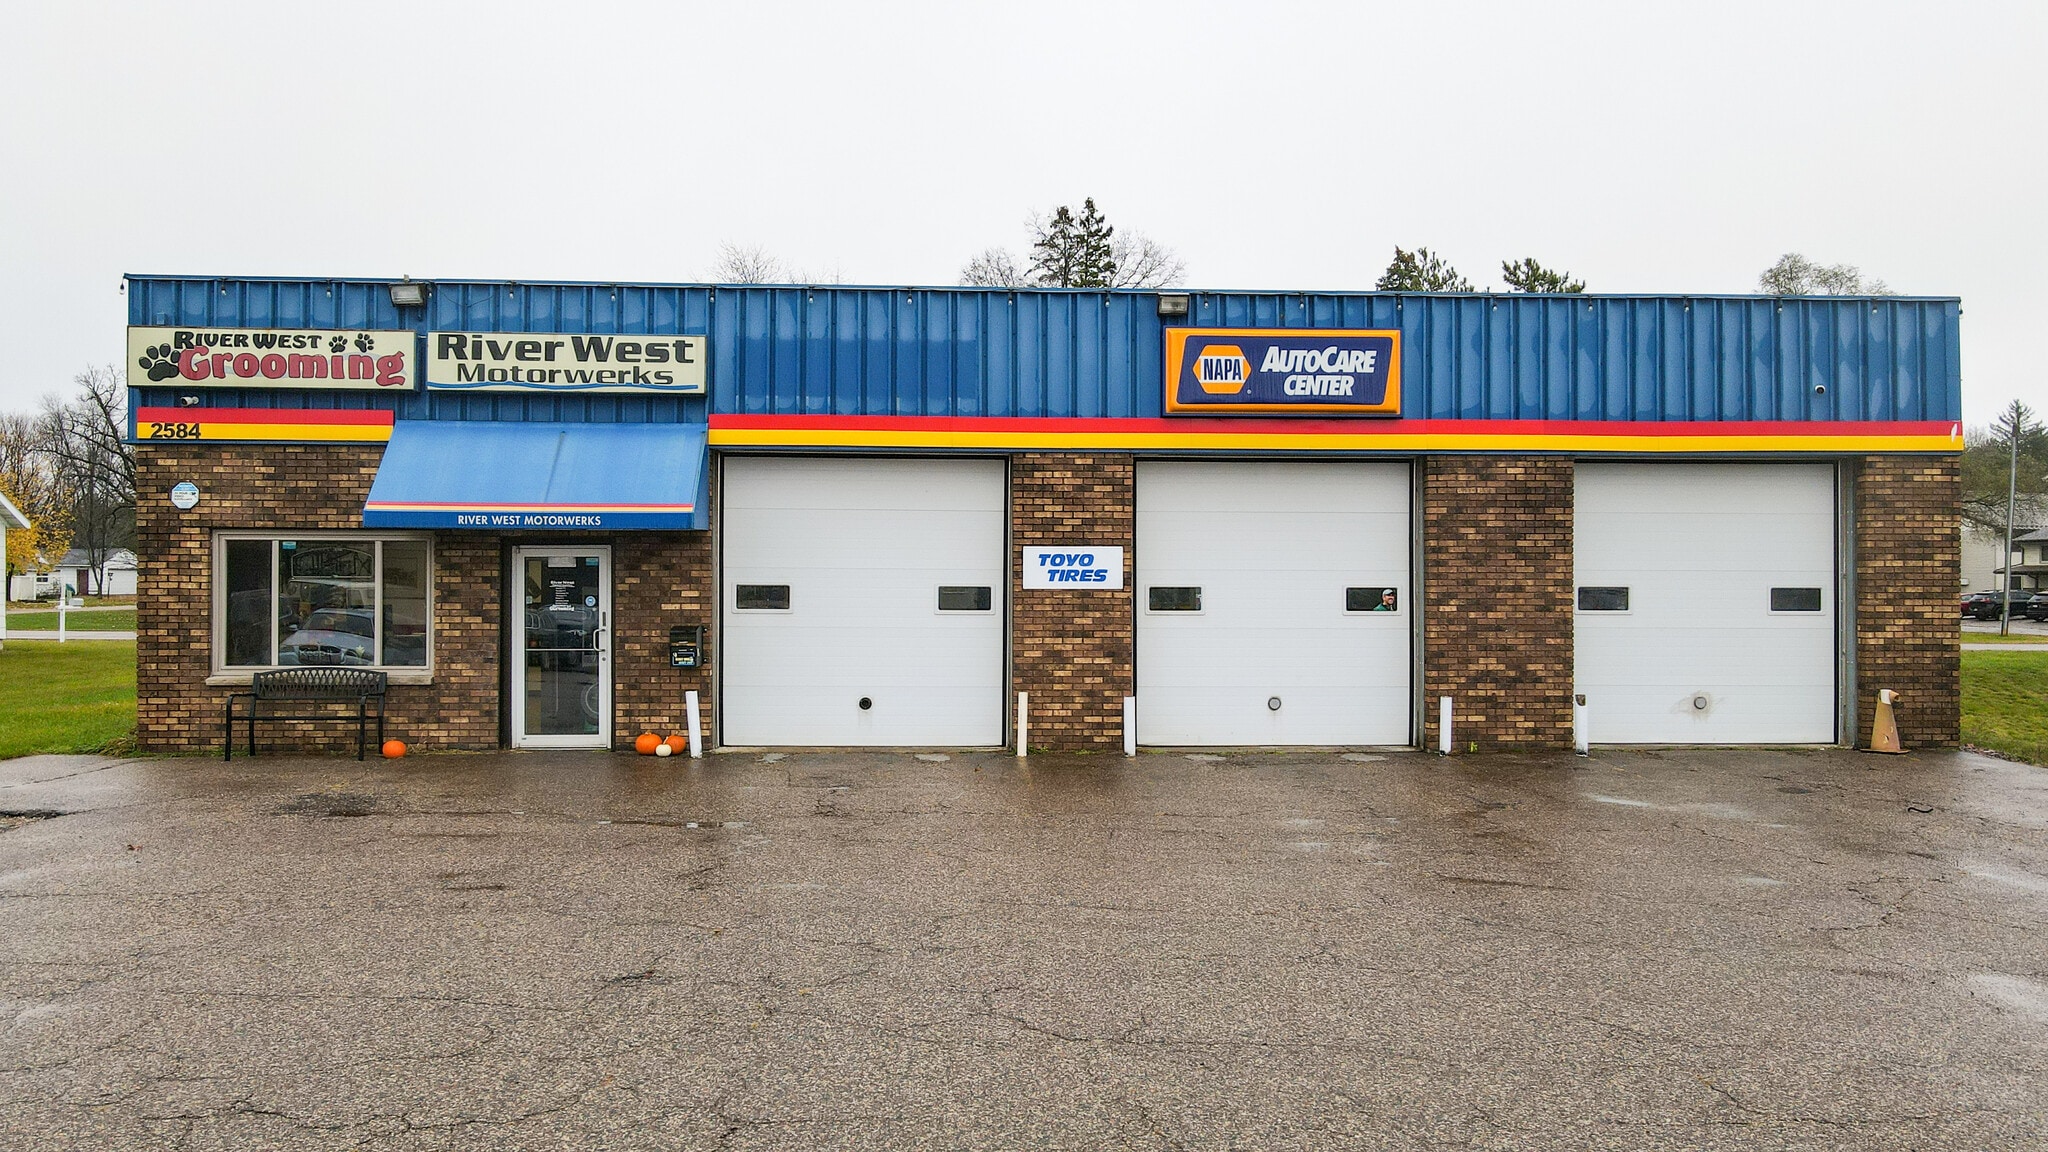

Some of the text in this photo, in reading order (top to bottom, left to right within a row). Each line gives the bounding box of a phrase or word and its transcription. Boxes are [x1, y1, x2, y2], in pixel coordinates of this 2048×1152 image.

[174, 331, 322, 349] RIVER WEST
[437, 334, 695, 363] River West
[178, 345, 406, 386] Grooming
[457, 363, 674, 385] Motorwerks
[1203, 358, 1242, 381] NAPA
[1283, 375, 1354, 396] CENTER
[150, 422, 201, 439] 2584
[457, 515, 601, 526] RIVER WEST MOTORWERKS
[1038, 554, 1094, 567] TOYO
[1047, 569, 1108, 582] TIRES
